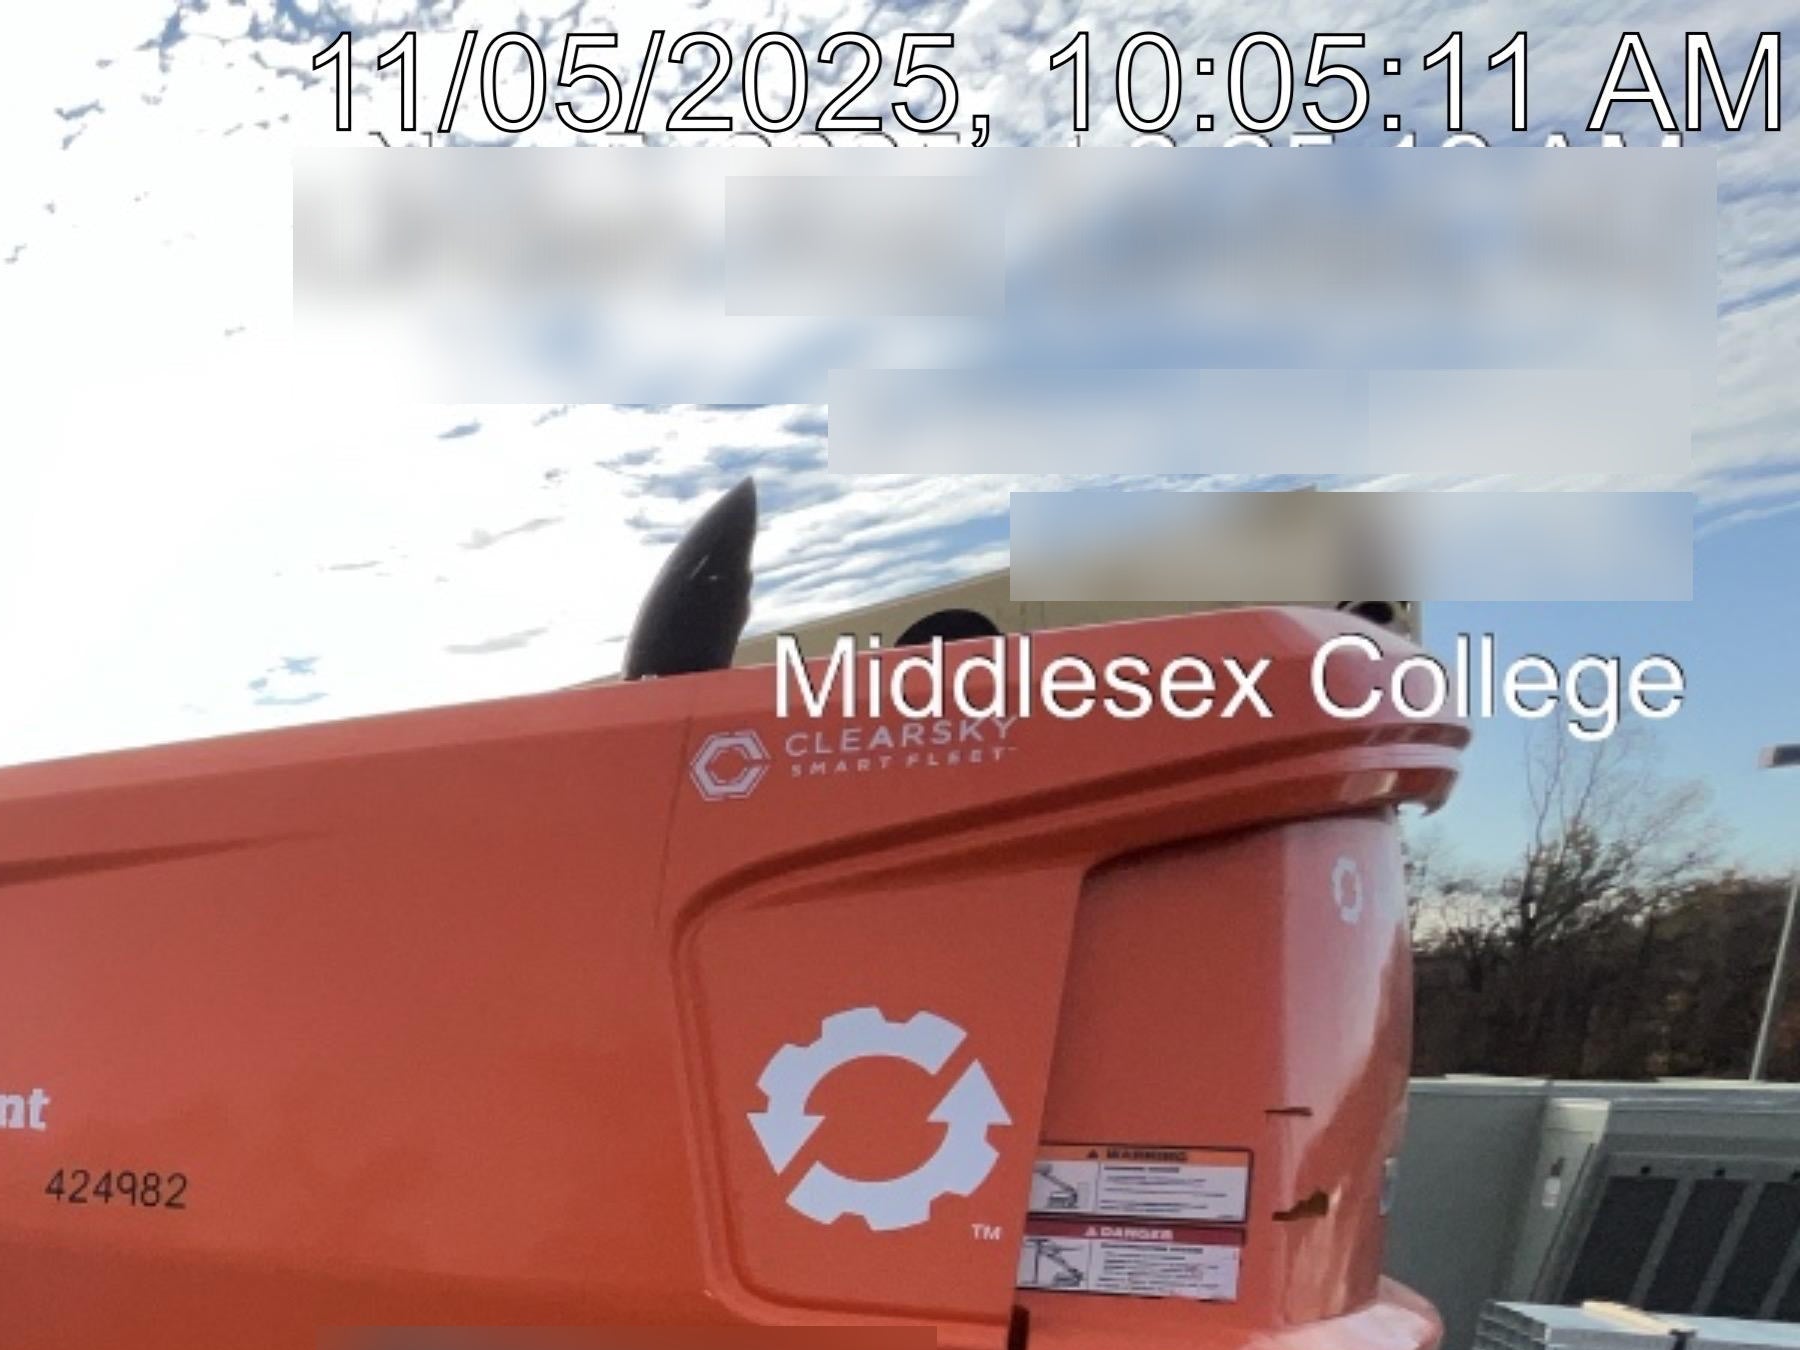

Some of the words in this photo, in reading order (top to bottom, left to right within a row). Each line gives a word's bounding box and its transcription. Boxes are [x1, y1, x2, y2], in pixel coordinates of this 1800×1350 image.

[784, 717, 1017, 757] CLEARSKY
[791, 757, 892, 778] SMART
[46, 1169, 188, 1208] 424982
